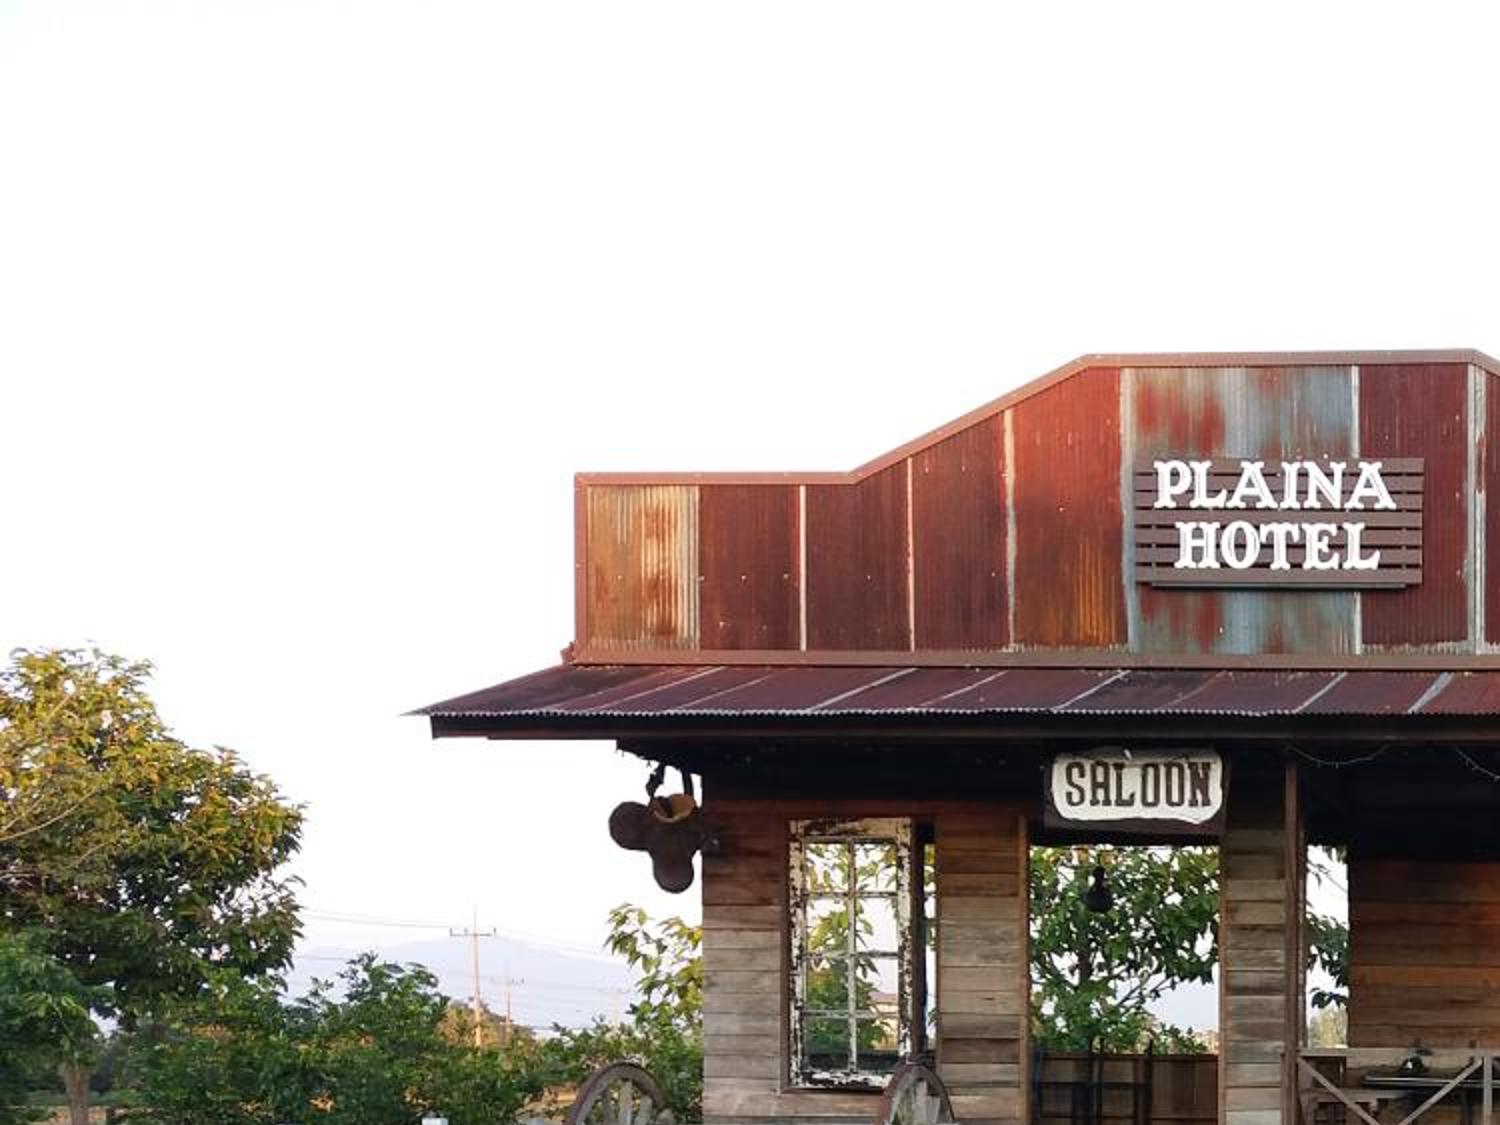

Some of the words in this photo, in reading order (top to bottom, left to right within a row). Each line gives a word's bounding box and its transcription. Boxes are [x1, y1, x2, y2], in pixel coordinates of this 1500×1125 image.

[1153, 459, 1397, 510] PLAINA
[1173, 520, 1381, 570] HOTEL
[1065, 760, 1212, 808] SALOON
